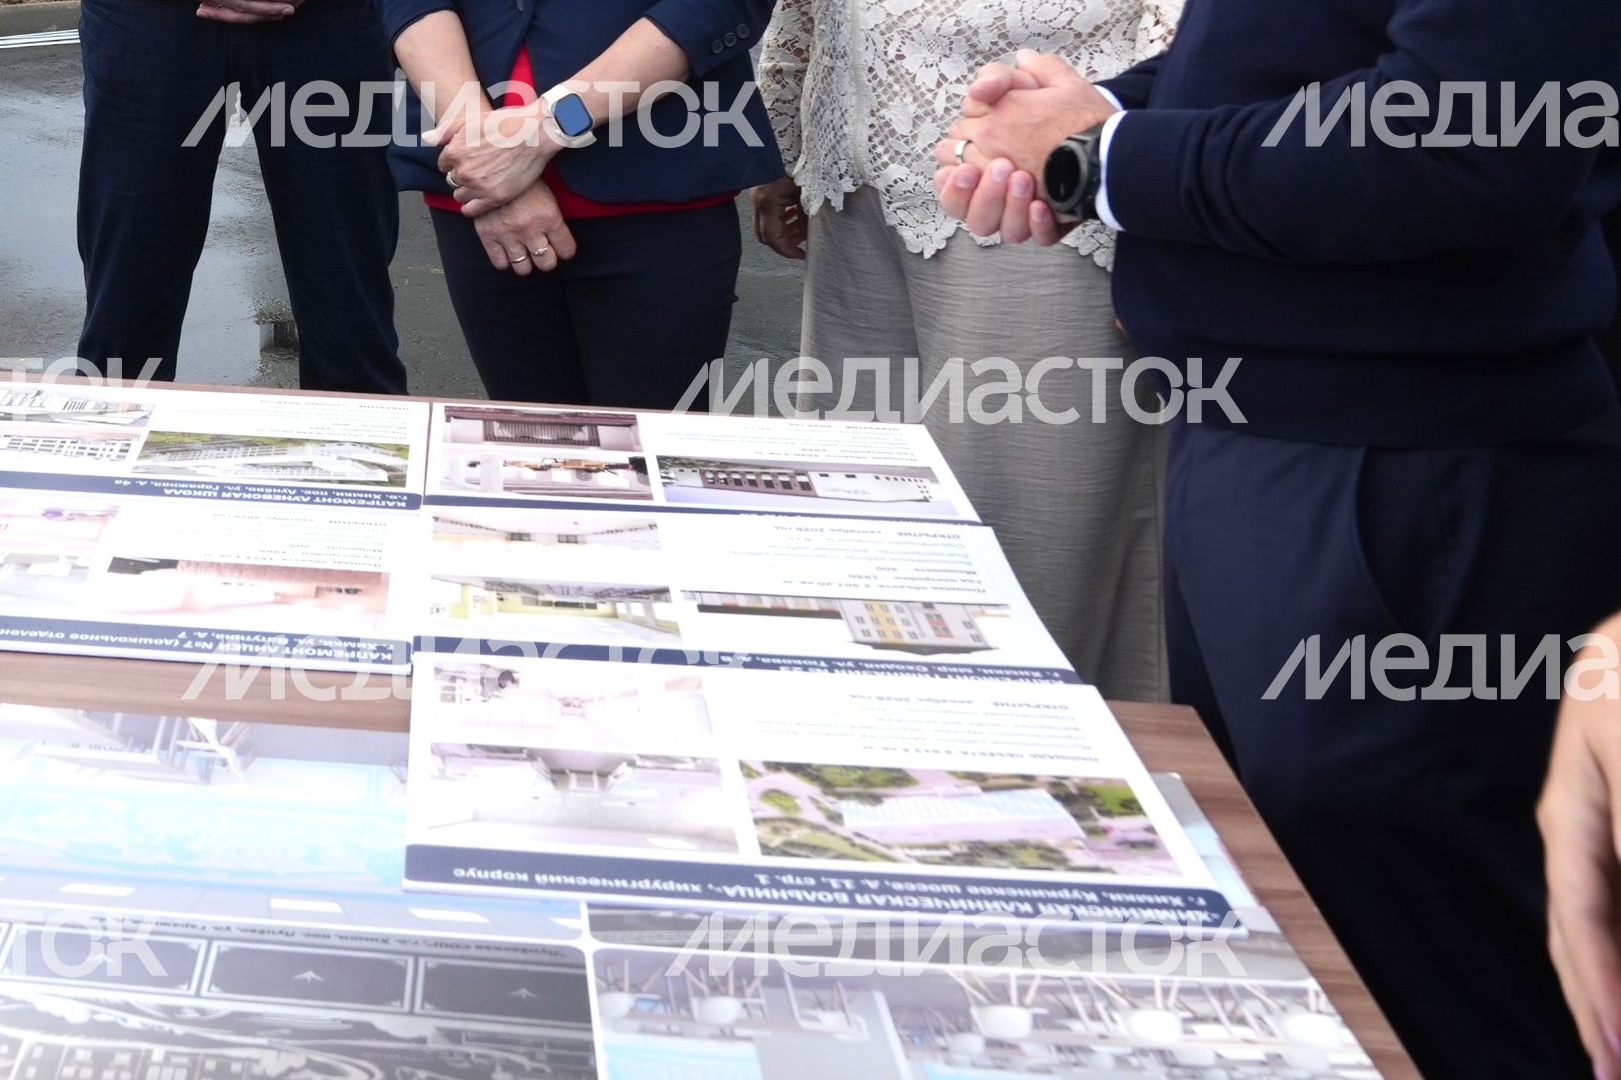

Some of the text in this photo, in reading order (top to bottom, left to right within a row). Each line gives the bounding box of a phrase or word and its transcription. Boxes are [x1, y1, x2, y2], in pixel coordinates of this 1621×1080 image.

[160, 487, 406, 507] КАПРЕМОНТ ЛУНЕВСКАЯ ШКОЛА
[452, 866, 528, 883] корпус
[534, 871, 703, 895] хирургический
[852, 890, 1034, 914] КЛИНИЧЕСКАЯ
